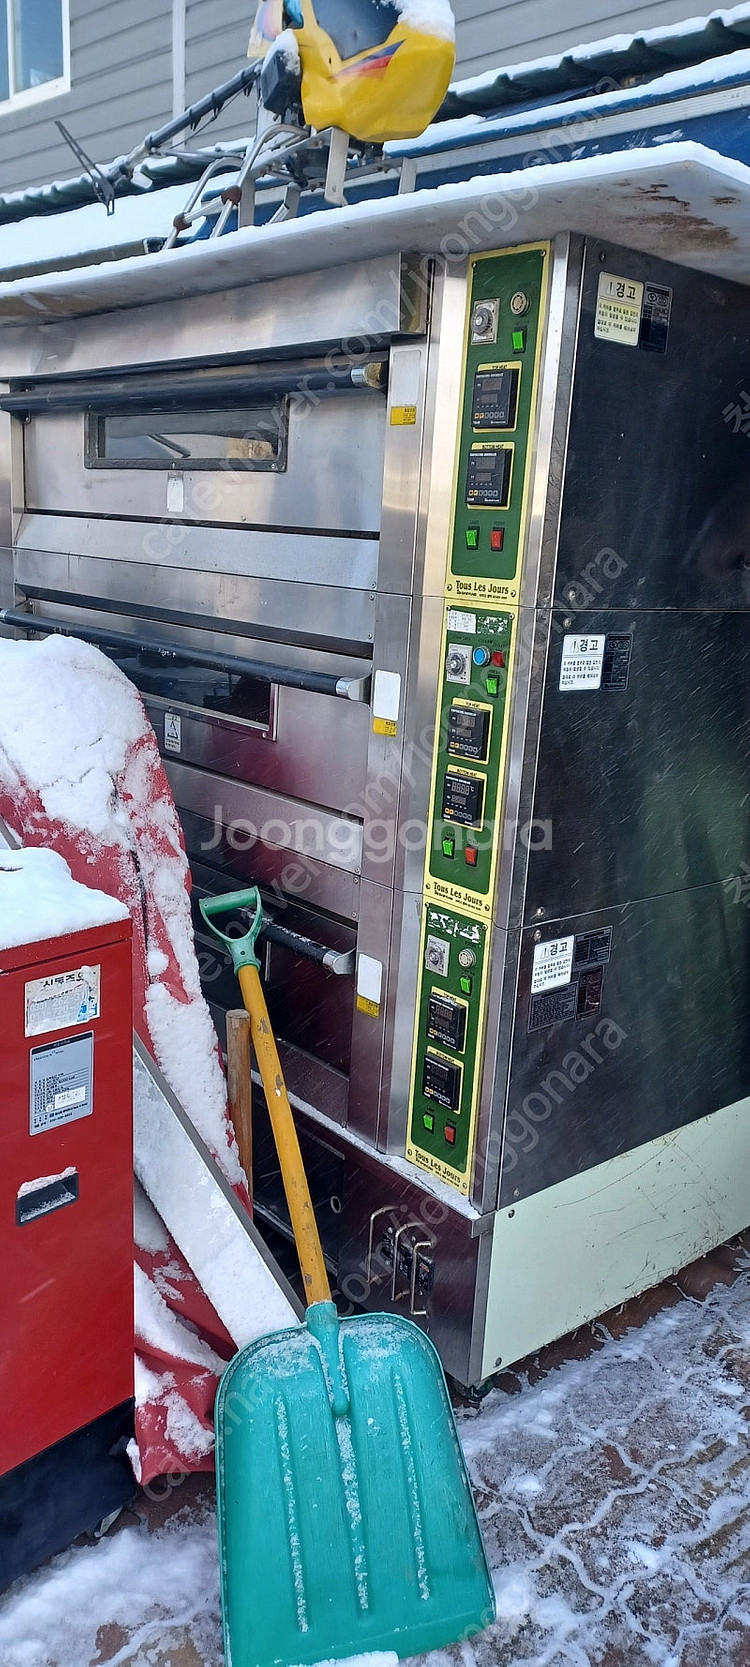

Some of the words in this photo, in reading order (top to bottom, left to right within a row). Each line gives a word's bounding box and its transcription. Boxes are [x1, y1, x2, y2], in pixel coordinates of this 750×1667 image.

[616, 282, 636, 300] 경고
[456, 580, 472, 591] Tous
[474, 582, 486, 592] Les
[488, 583, 510, 595] Jours
[579, 638, 599, 652] 경고
[434, 881, 449, 894] Tous
[450, 887, 462, 899] Les
[463, 893, 483, 907] Jours
[550, 941, 568, 956] 경고
[415, 1149, 429, 1164] Tous
[430, 1158, 441, 1170] Les
[442, 1167, 461, 1183] Jours
